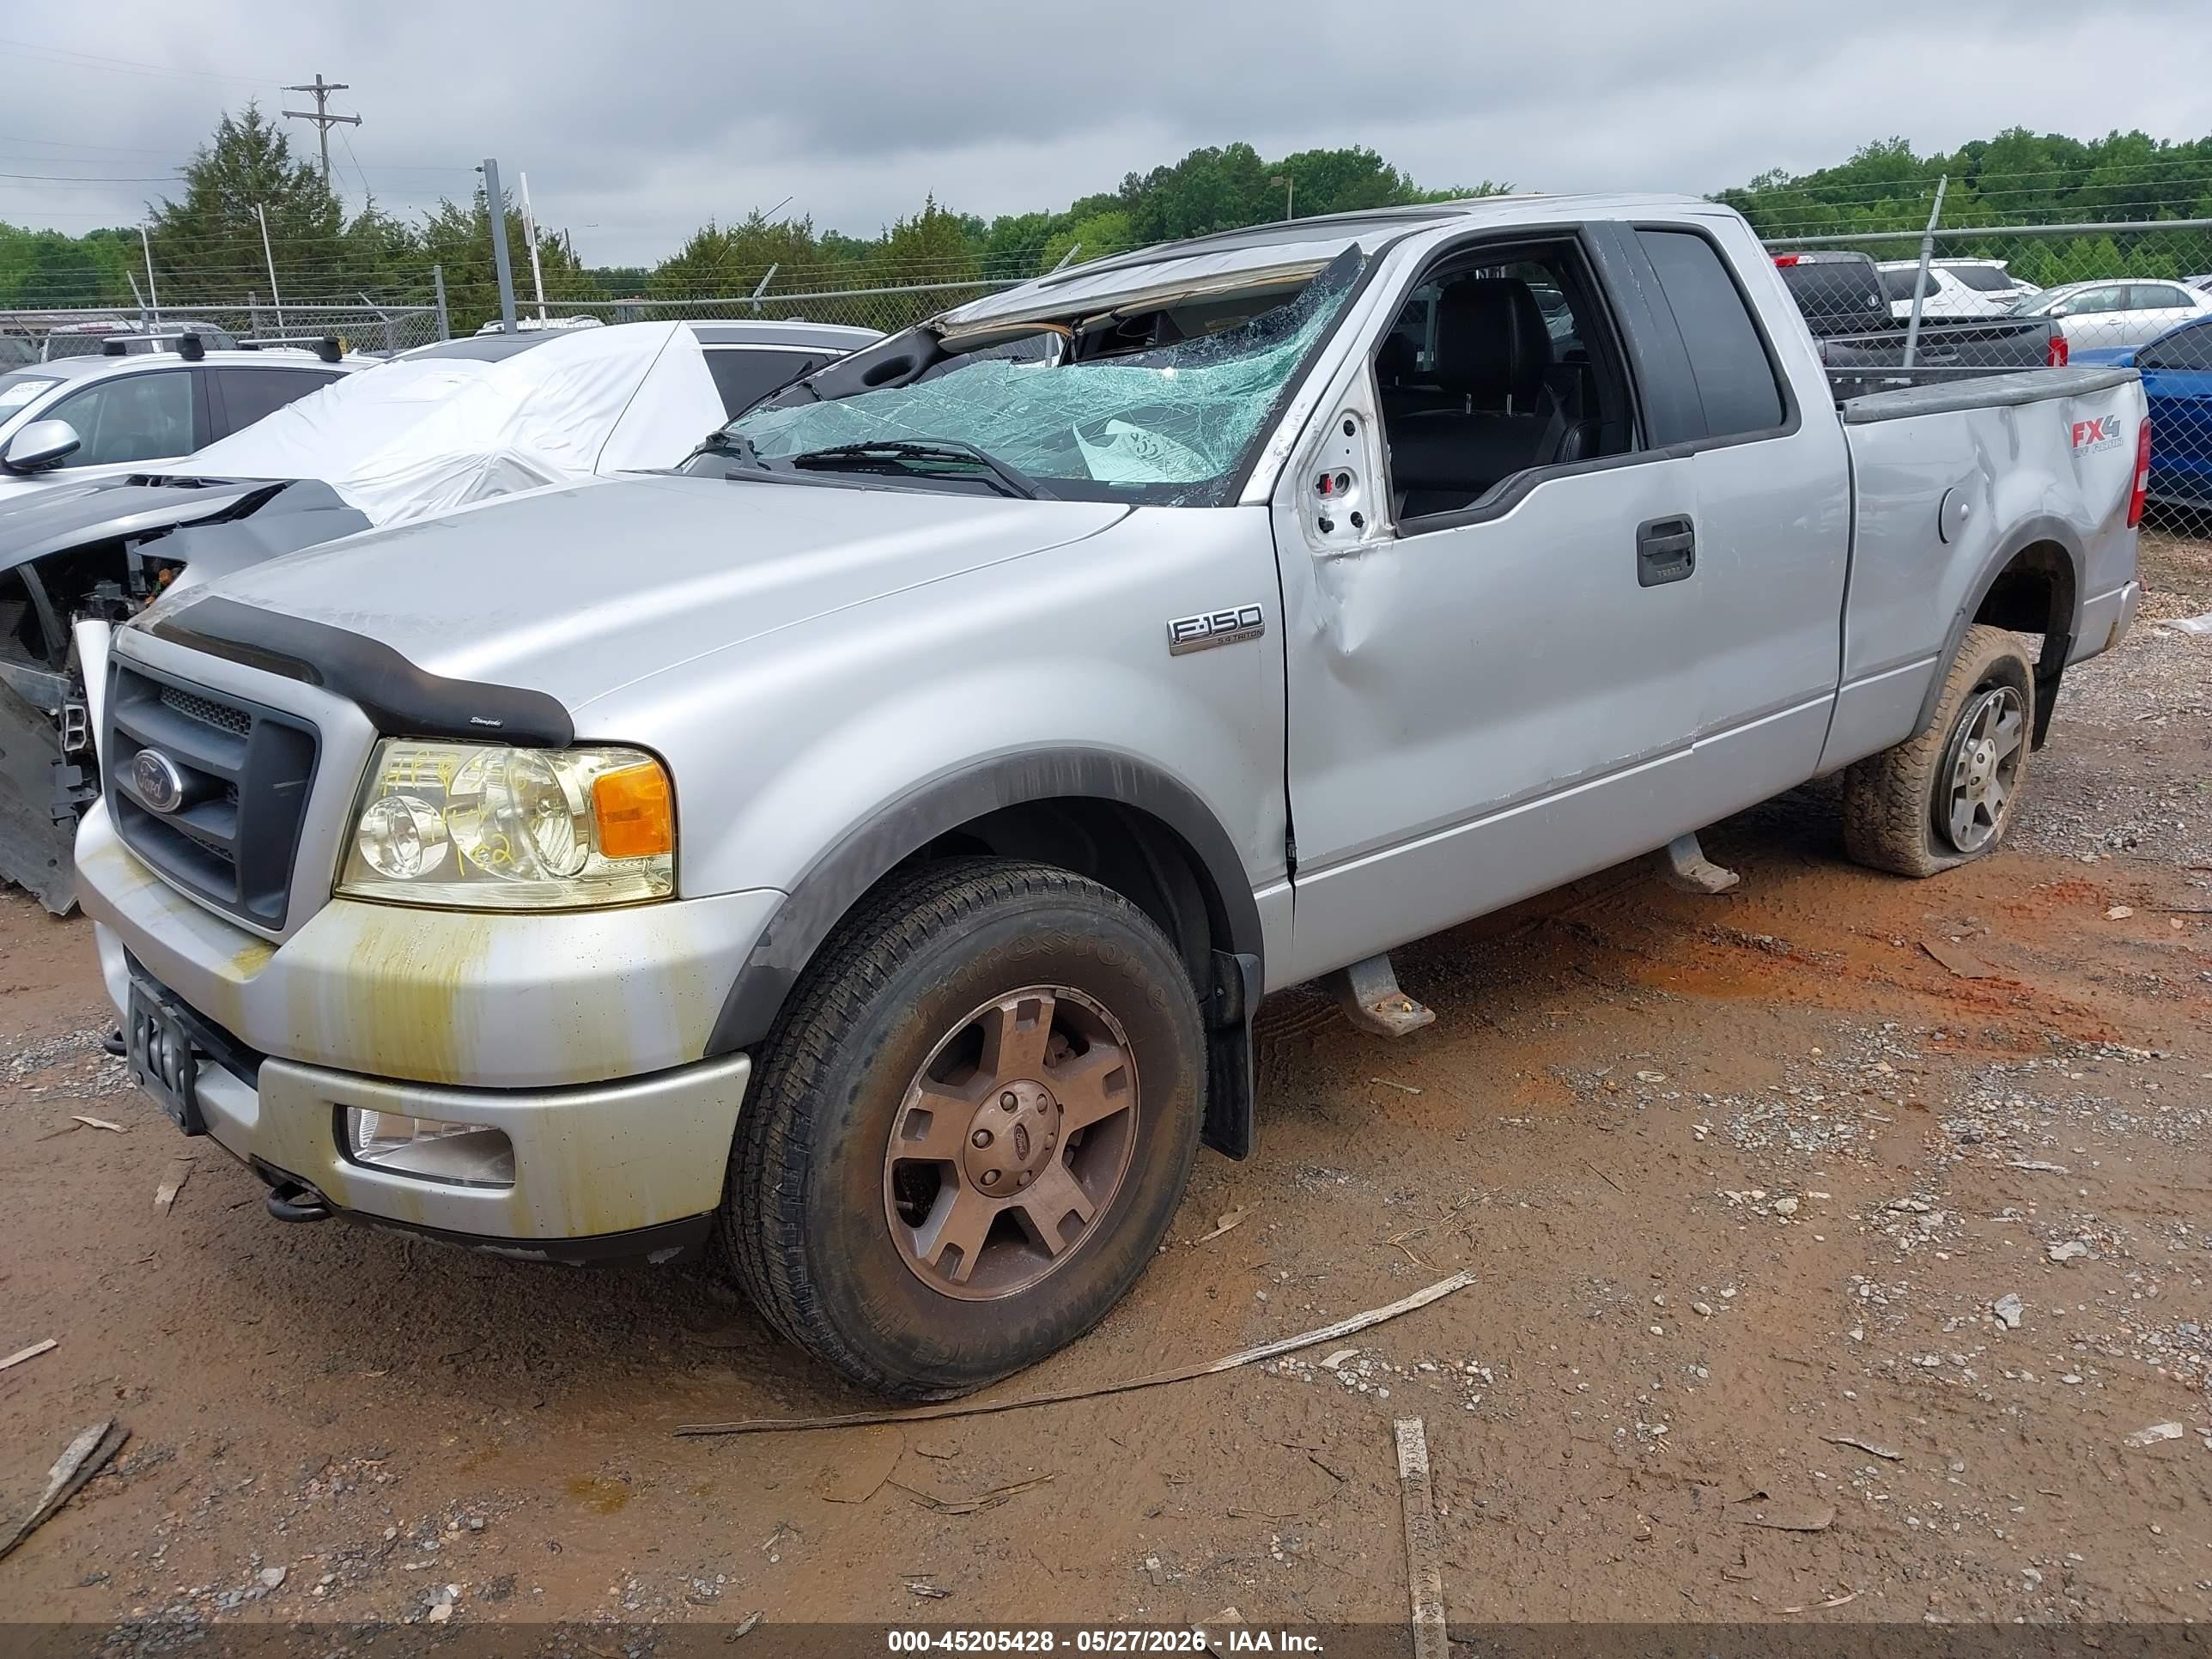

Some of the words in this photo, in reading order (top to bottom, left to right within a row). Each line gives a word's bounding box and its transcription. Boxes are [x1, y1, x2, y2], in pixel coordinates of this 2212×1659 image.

[2072, 415, 2121, 448] FX4
[1172, 606, 1262, 644] F-150
[1233, 629, 1263, 641] TRITON
[137, 761, 163, 799] Ford
